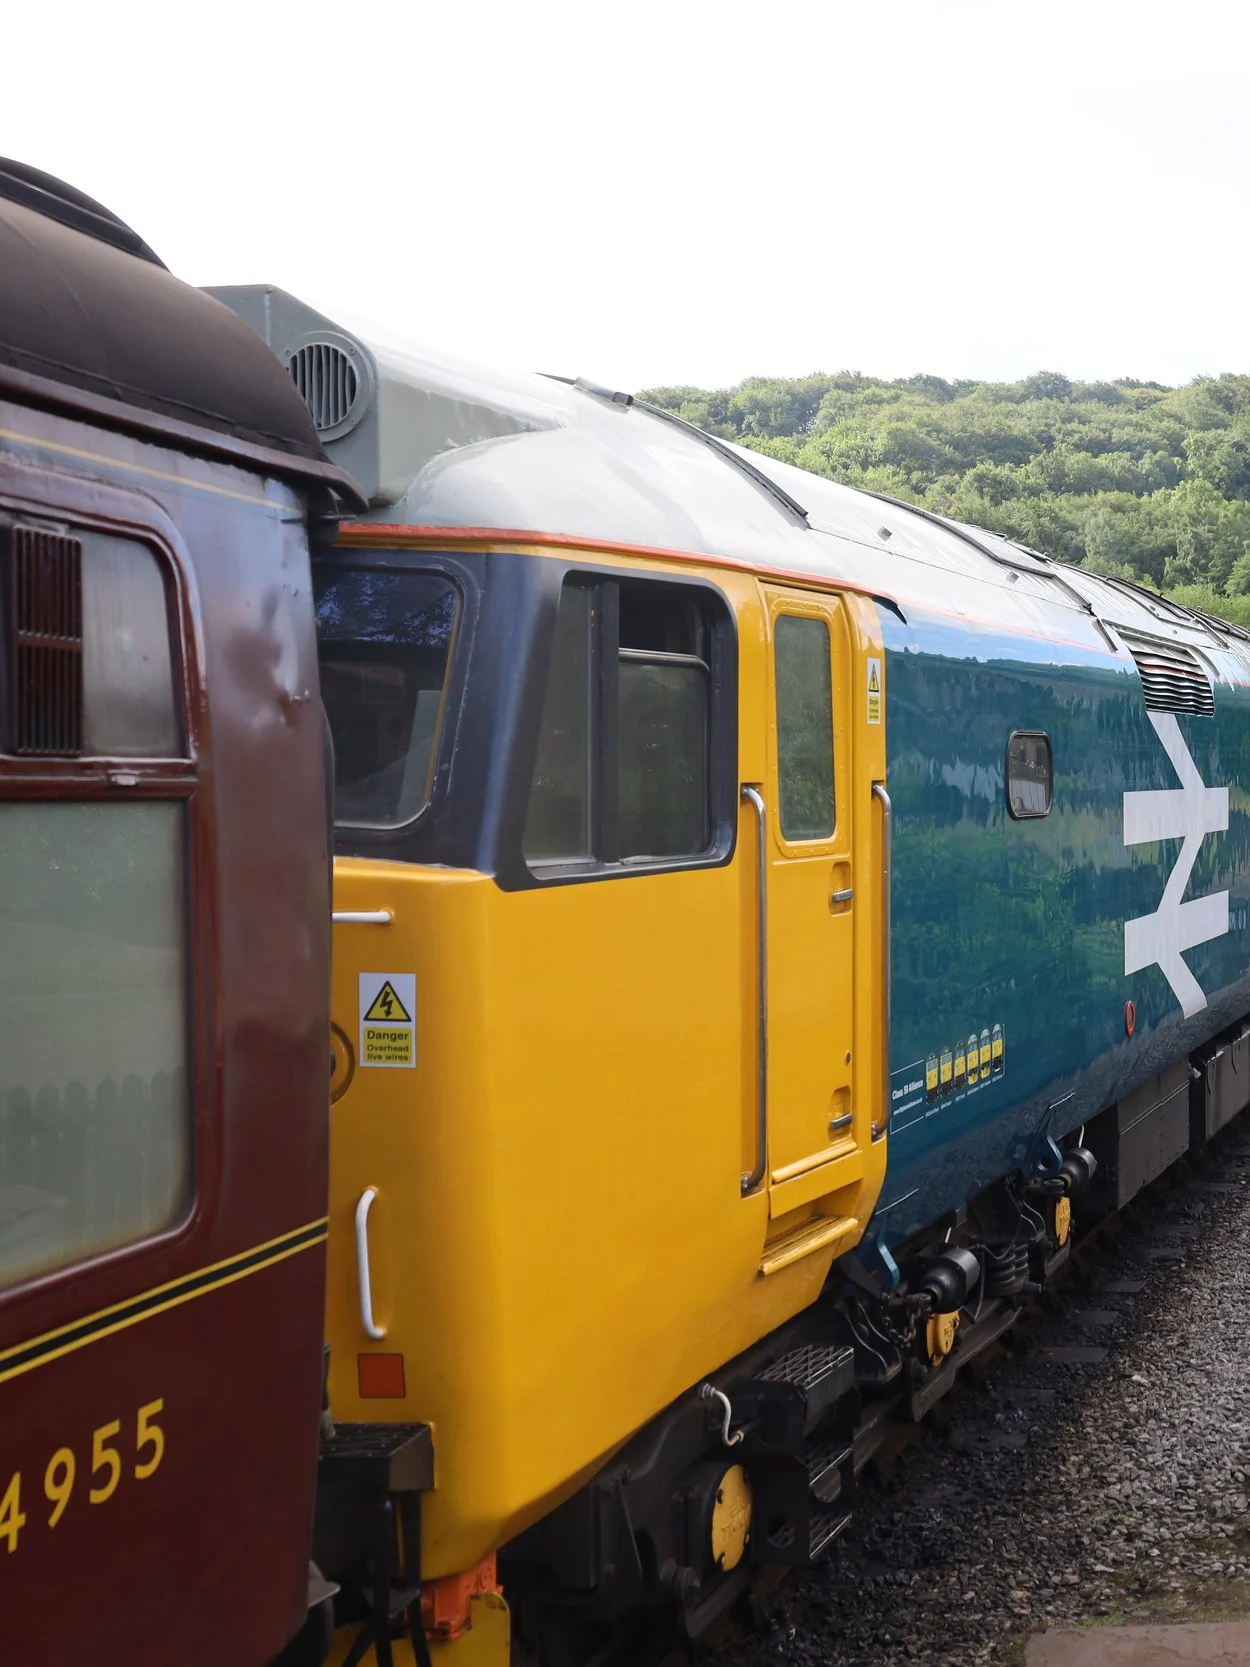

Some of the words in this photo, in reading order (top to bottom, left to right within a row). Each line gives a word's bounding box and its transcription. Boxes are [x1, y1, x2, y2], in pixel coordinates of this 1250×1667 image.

[367, 1030, 409, 1042] Danger
[367, 1044, 409, 1052] Overhead
[367, 1053, 383, 1061] live
[385, 1053, 409, 1061] wires
[0, 1397, 165, 1553] 4955
